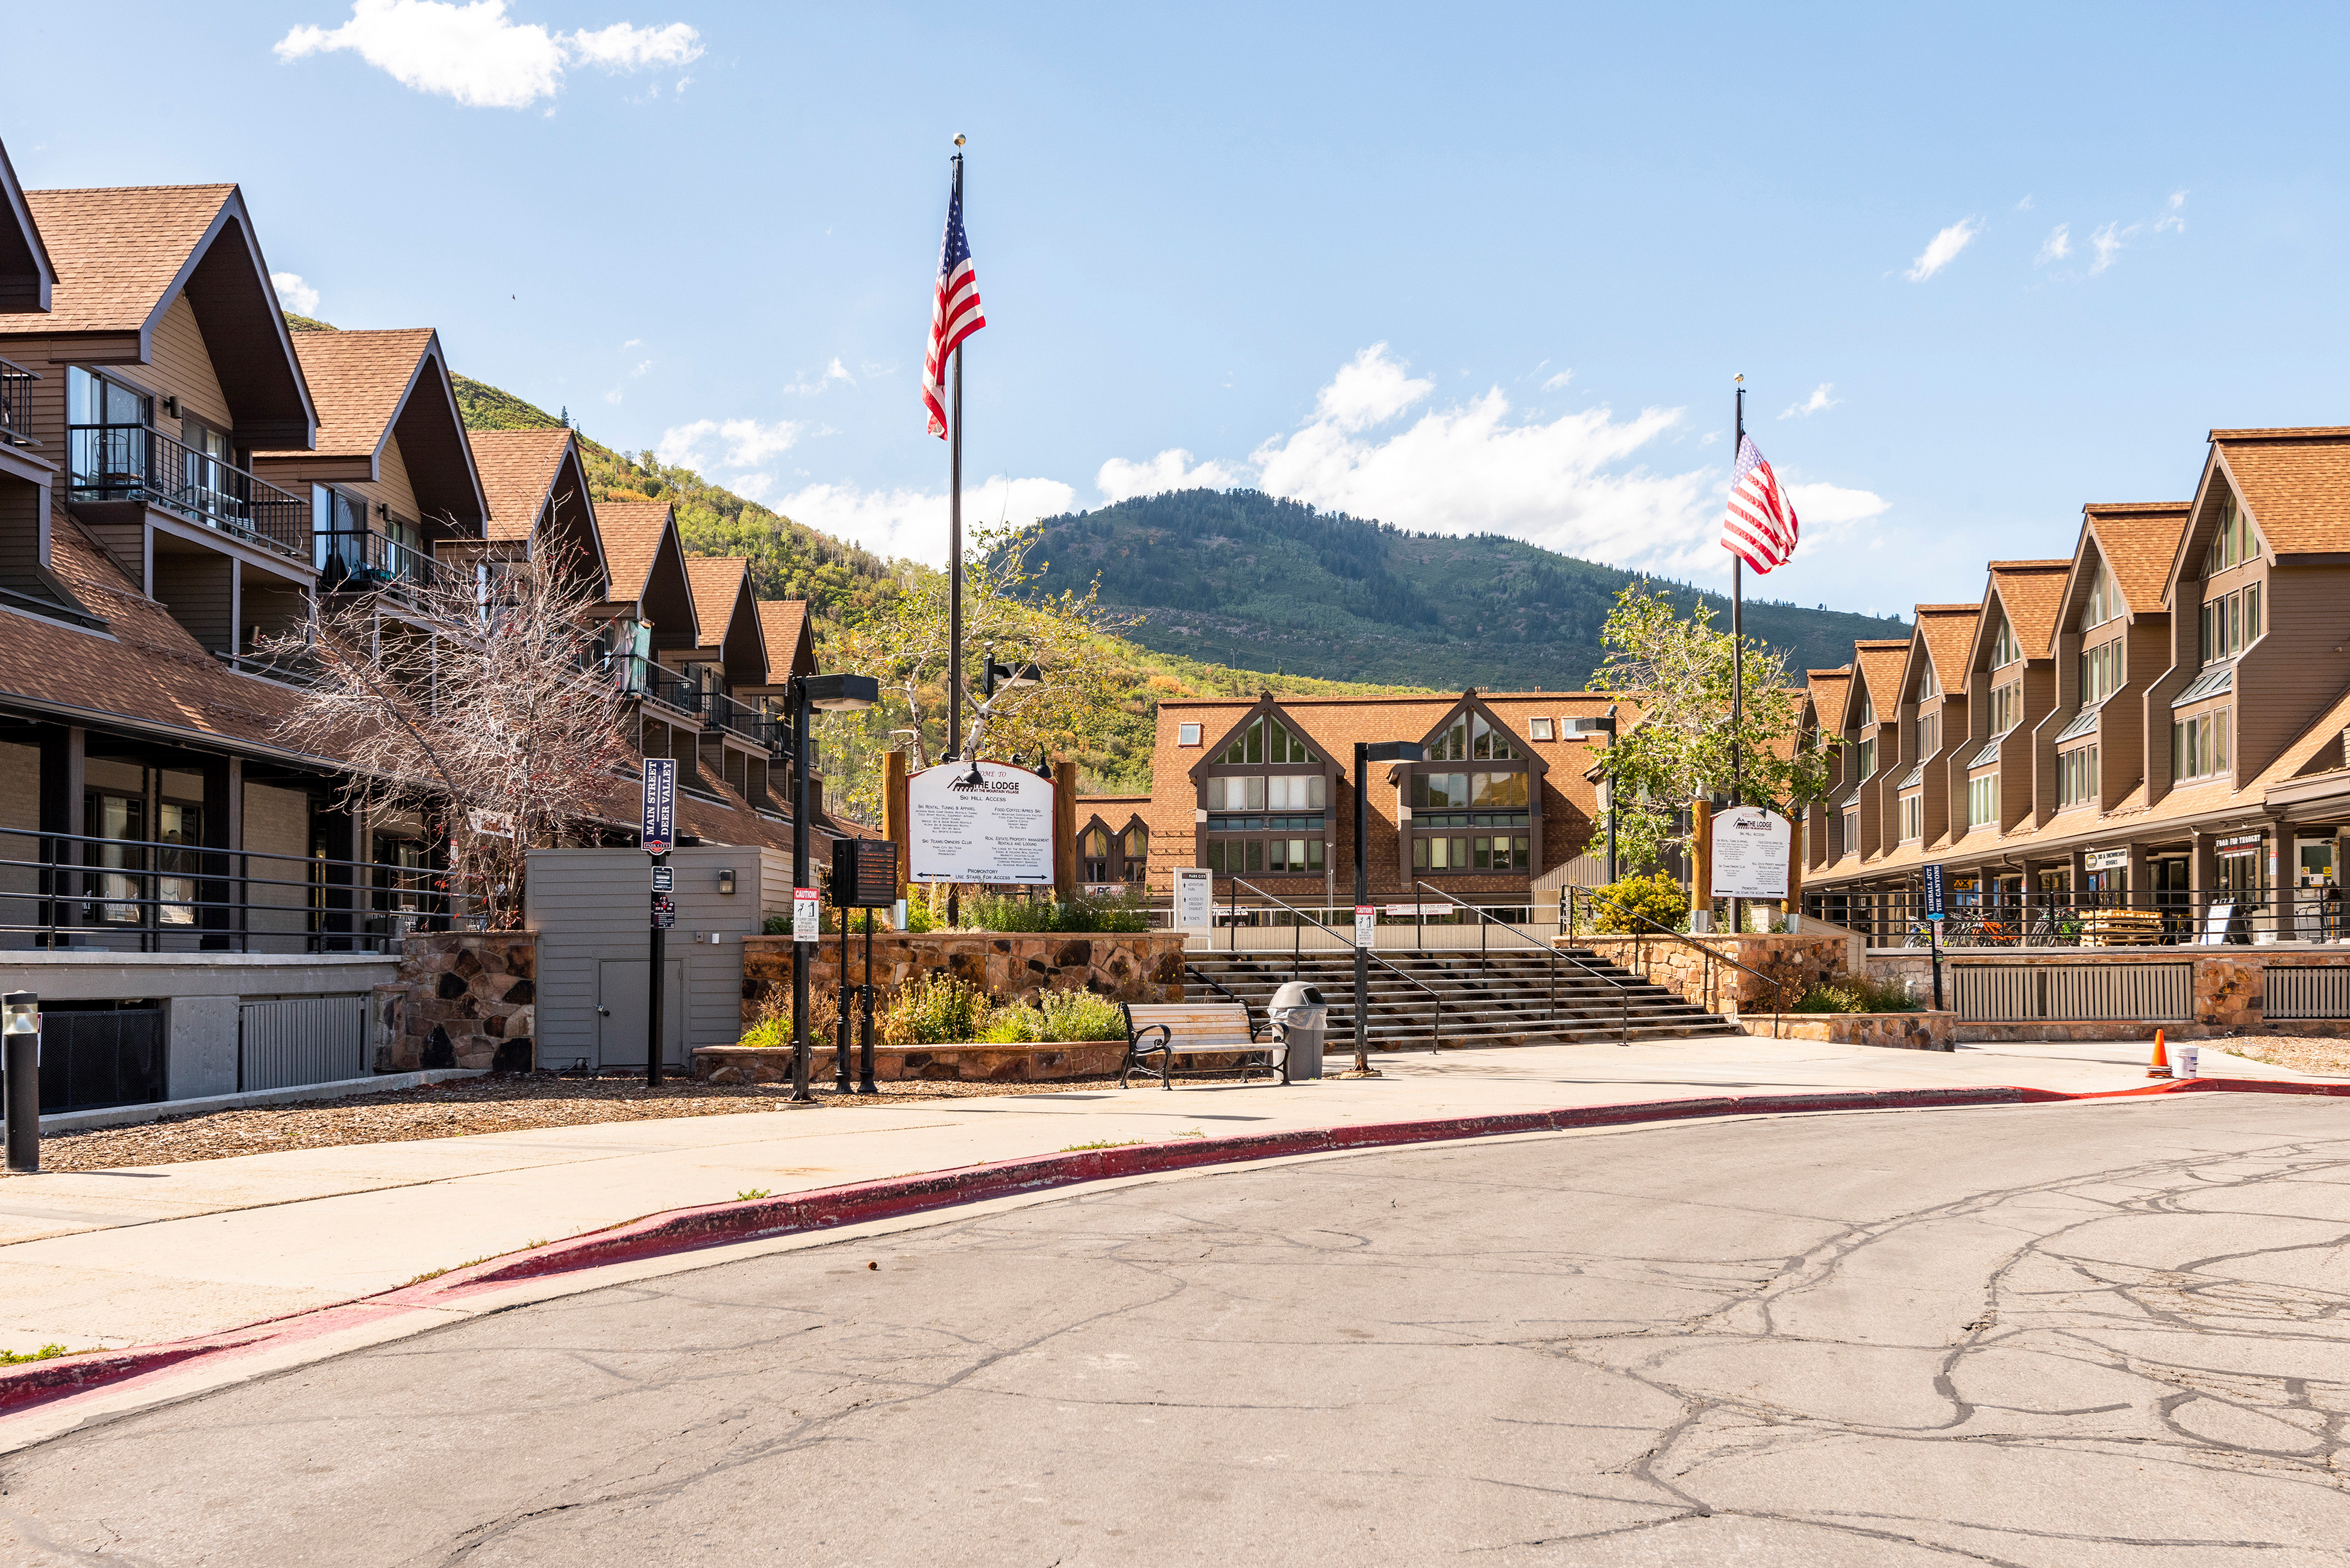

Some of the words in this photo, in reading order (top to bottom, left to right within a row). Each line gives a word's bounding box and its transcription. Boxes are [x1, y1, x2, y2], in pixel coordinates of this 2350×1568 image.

[647, 762, 657, 804] STREET
[662, 762, 671, 804] VALLEY
[992, 781, 1019, 790] LODGE
[647, 806, 655, 836] MAIN
[661, 805, 670, 836] DEER
[2239, 834, 2261, 844] THOUGHT
[795, 890, 817, 898] CAUTION!
